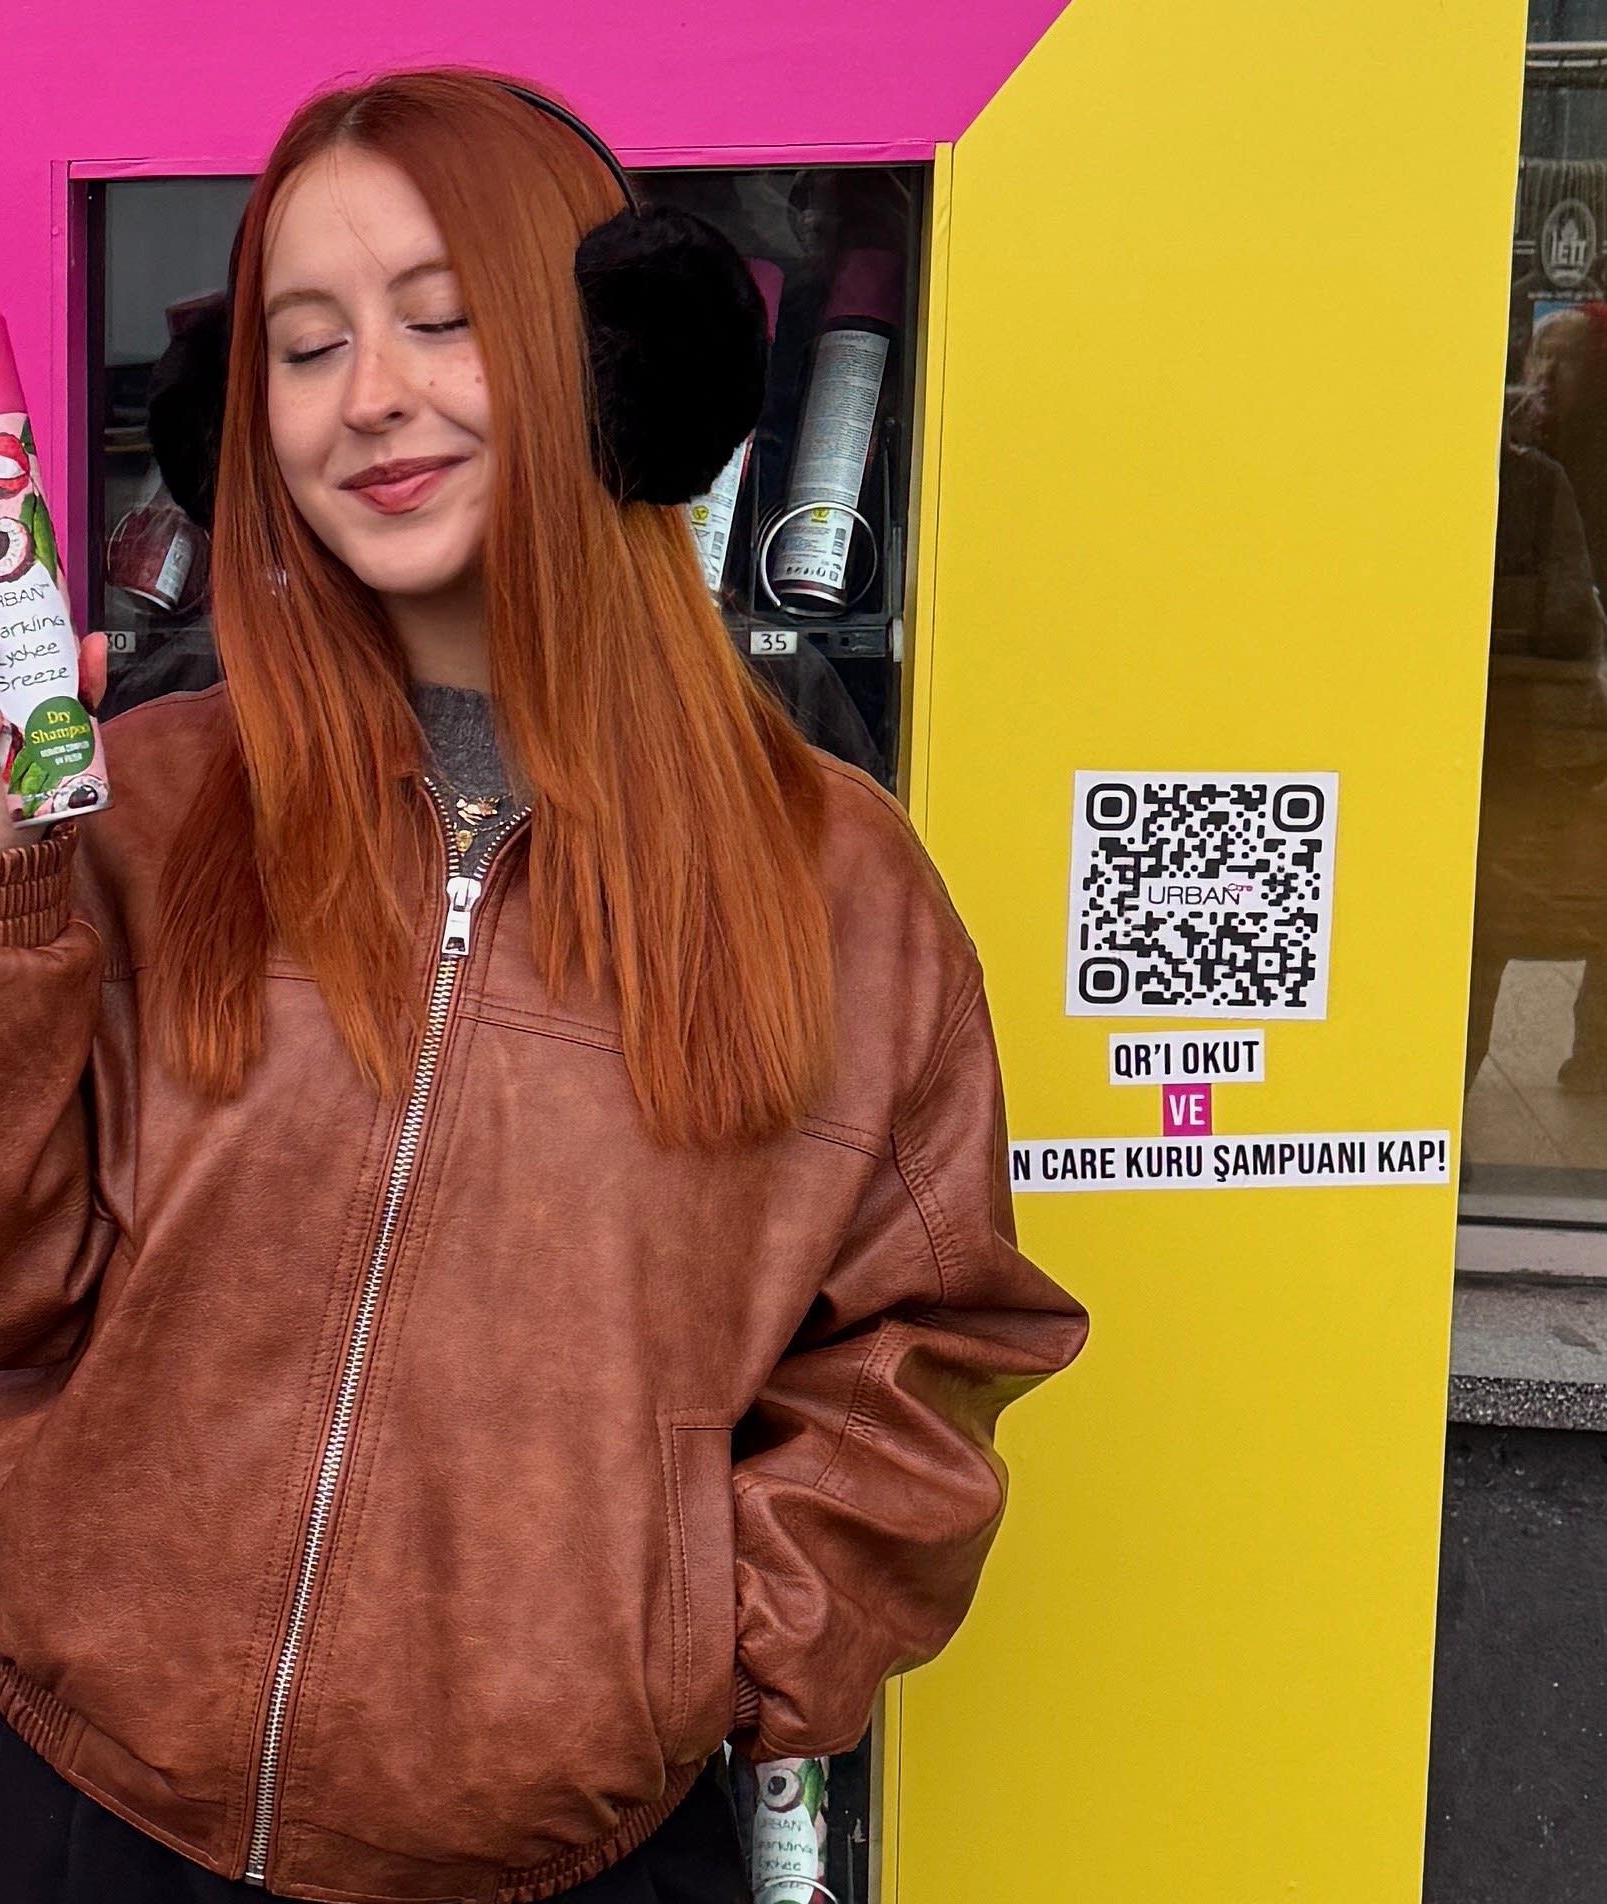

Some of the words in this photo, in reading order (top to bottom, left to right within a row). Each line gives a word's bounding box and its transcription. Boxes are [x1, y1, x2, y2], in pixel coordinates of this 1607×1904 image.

[760, 633, 787, 651] 35
[46, 711, 71, 725] Dry
[1148, 885, 1240, 905] URBAN
[1182, 1040, 1259, 1074] OKUT
[1169, 1094, 1205, 1126] VE
[1042, 1147, 1115, 1179] CARE
[1126, 1145, 1203, 1178] KURU
[1213, 1141, 1366, 1182] ŞAMPUANI
[1379, 1139, 1445, 1172] KAP!
